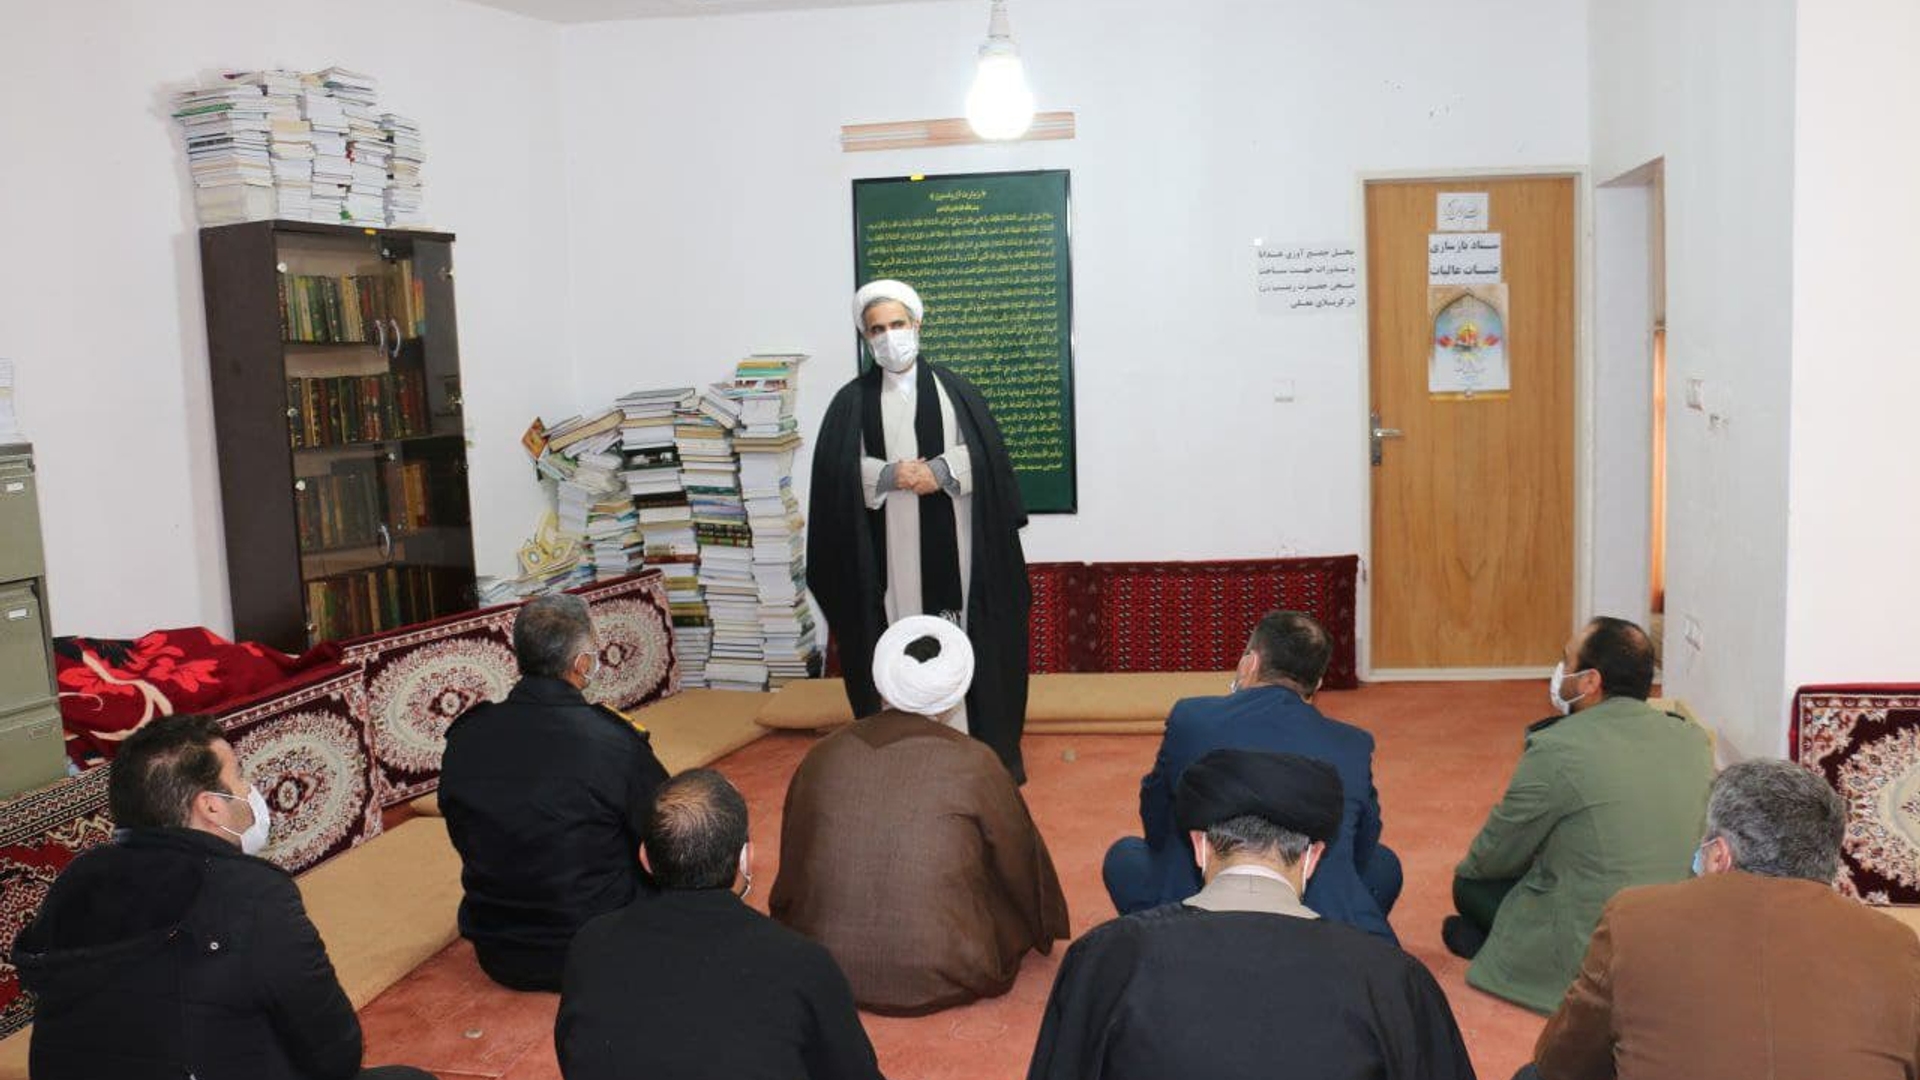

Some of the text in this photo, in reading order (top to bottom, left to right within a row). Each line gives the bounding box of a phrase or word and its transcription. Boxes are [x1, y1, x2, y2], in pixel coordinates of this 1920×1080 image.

[1429, 240, 1499, 254] ستاد بازسازی
[1429, 264, 1499, 276] عتبات عالیات
